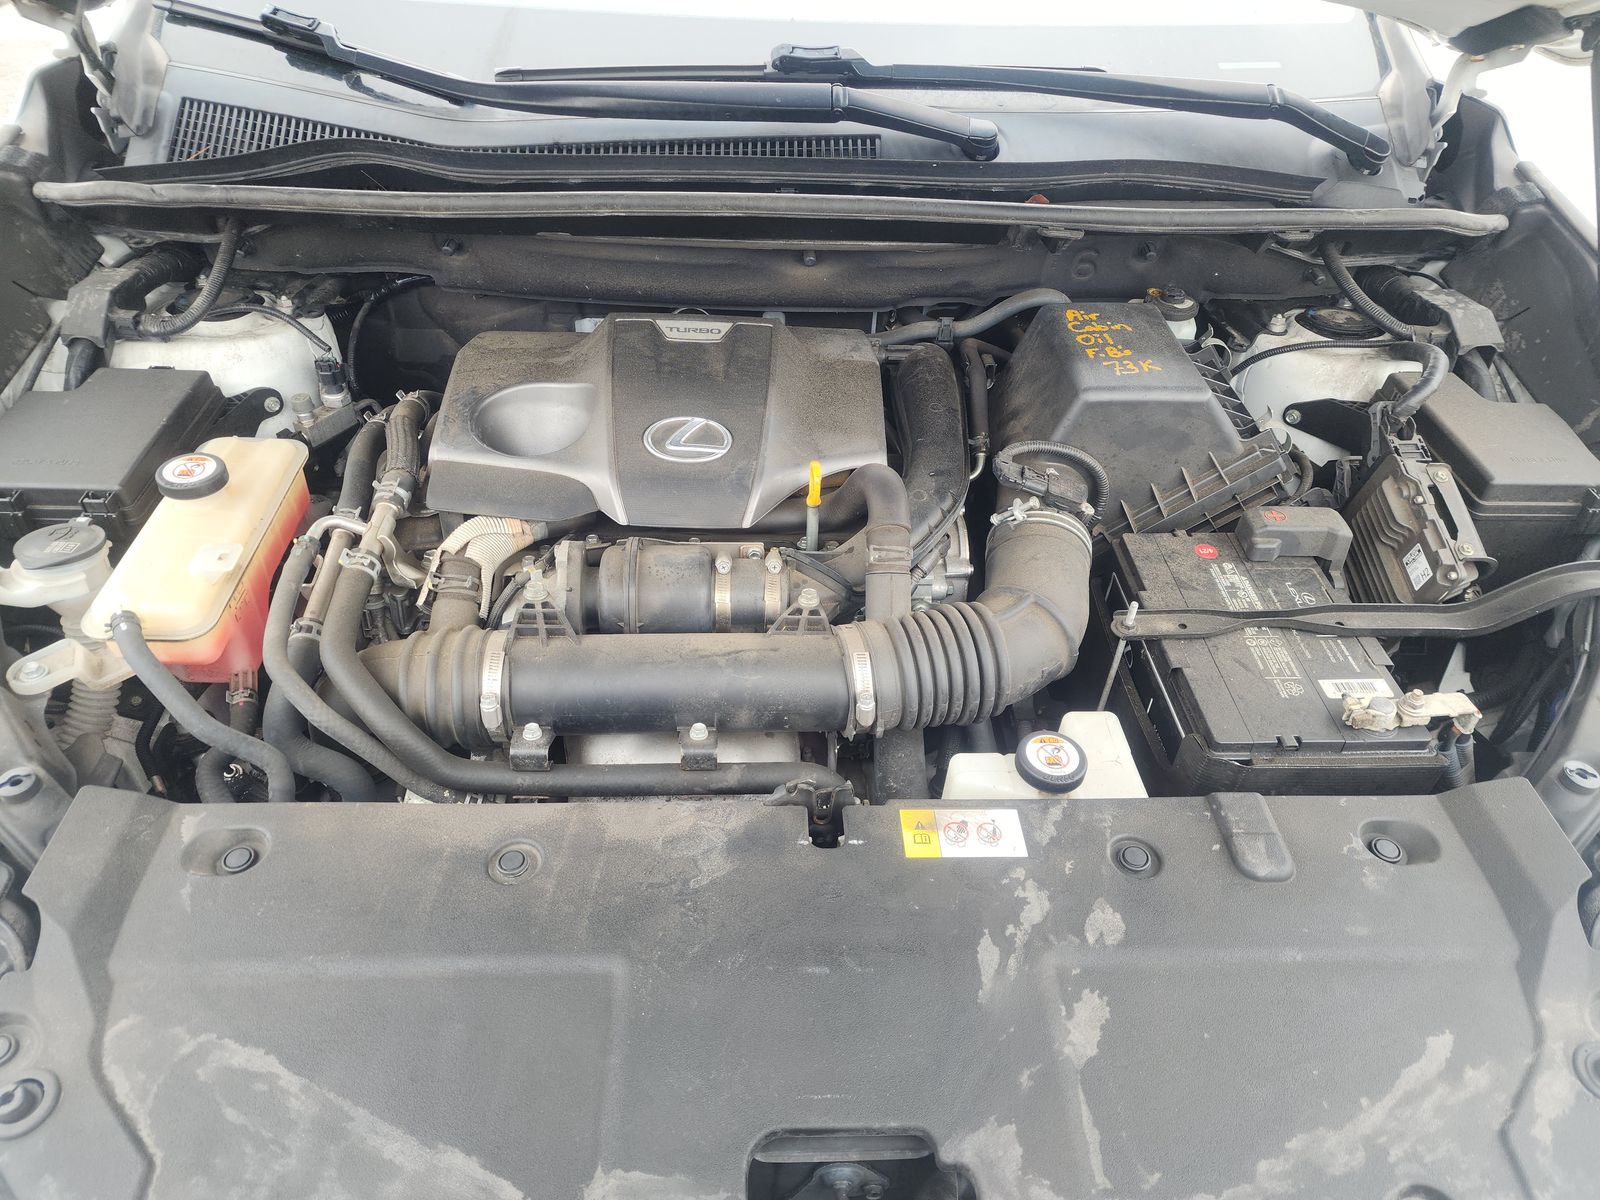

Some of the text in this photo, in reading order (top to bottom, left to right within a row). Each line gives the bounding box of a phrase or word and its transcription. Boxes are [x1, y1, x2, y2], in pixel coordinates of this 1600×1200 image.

[1065, 309, 1099, 321] Air
[665, 326, 721, 334] TURBO
[1067, 321, 1134, 333] Cabin
[1075, 333, 1114, 345] Oil
[1102, 360, 1162, 376] 73K
